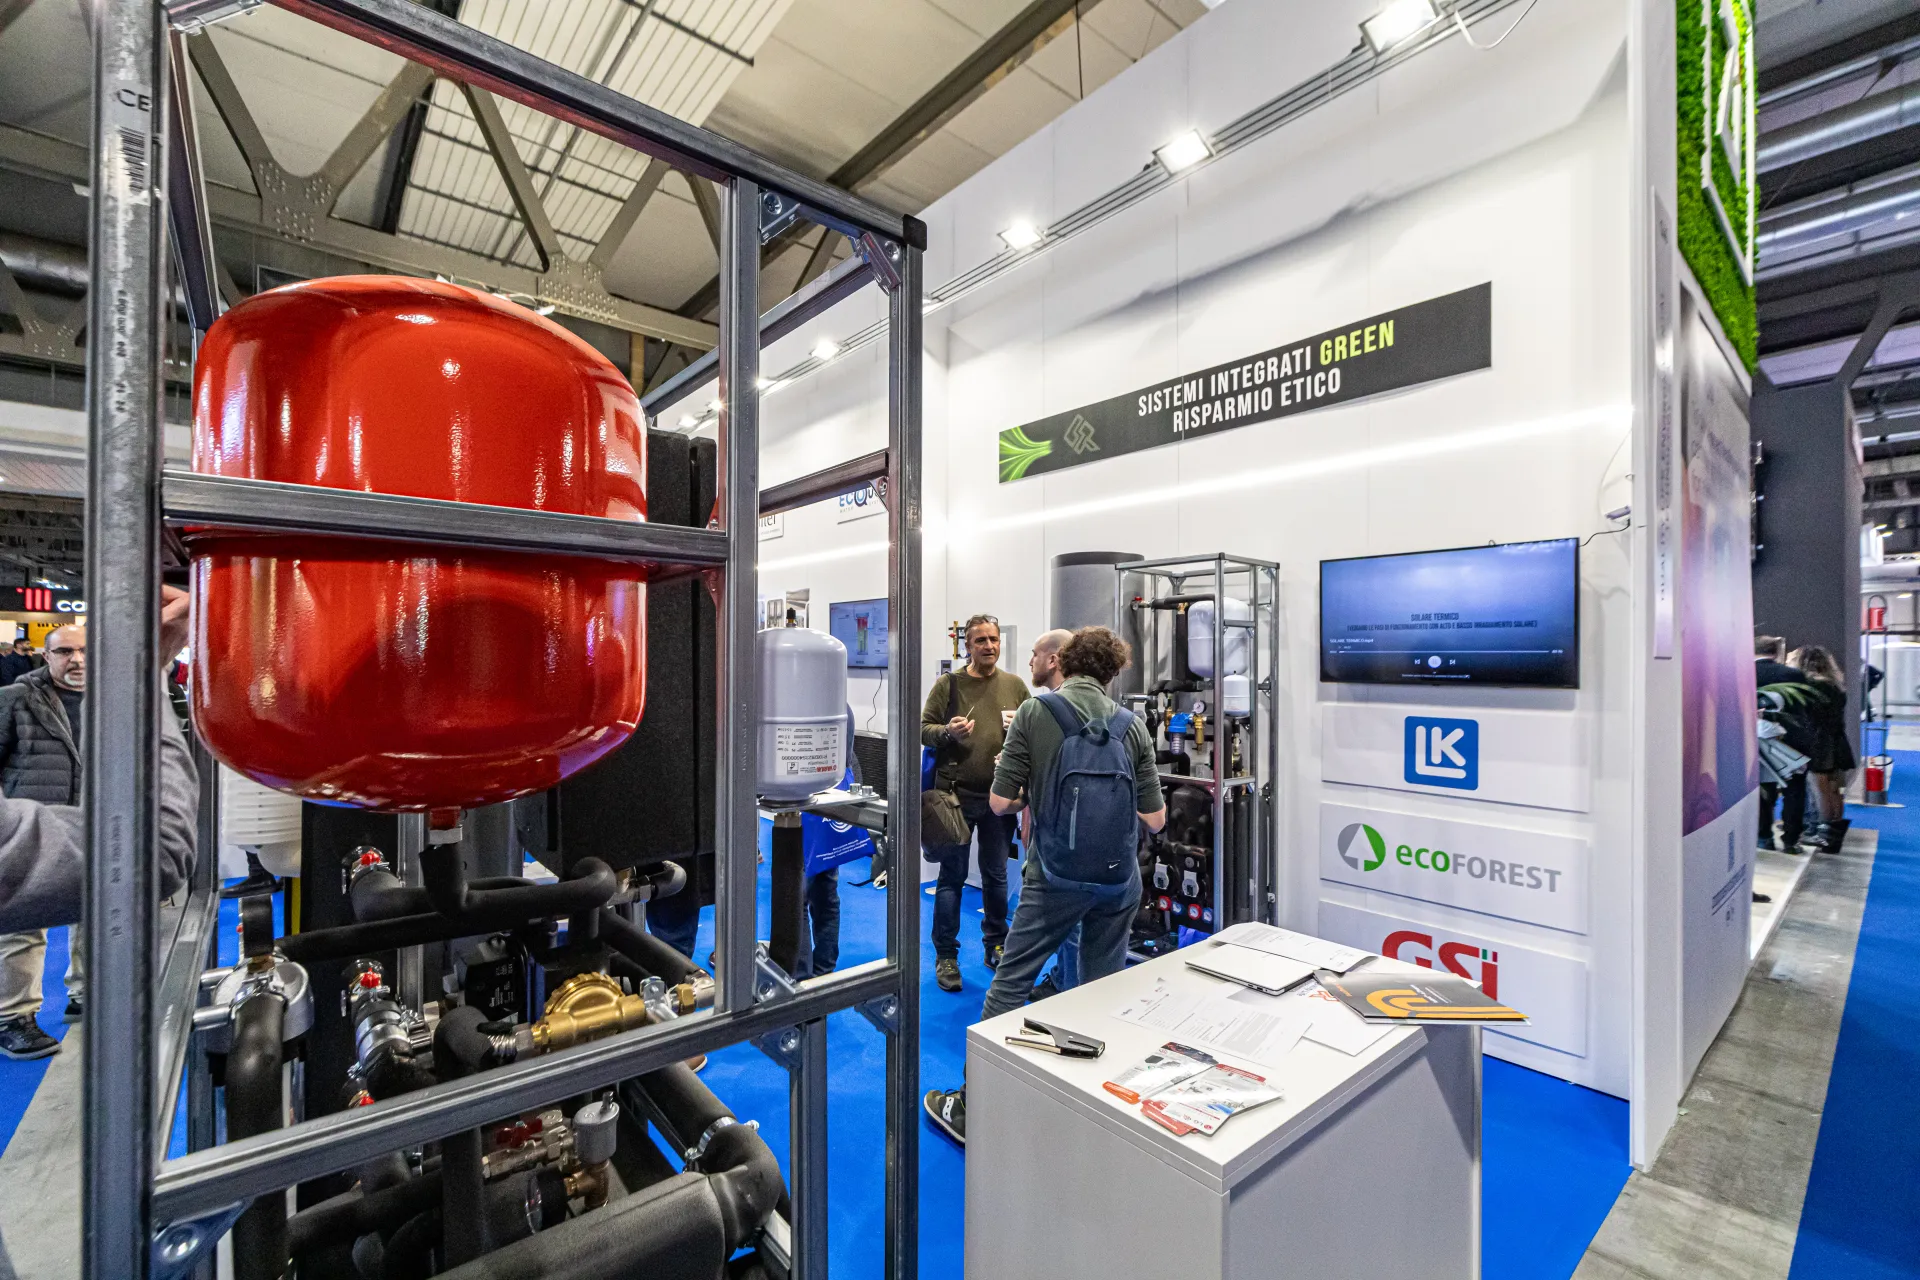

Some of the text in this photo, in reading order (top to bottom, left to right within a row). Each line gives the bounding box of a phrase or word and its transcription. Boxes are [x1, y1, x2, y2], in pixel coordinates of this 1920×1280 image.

[1138, 319, 1395, 417] SISTEMI INTEGRATI GREEN
[1172, 367, 1341, 432] RISPARMIO ETICO
[1410, 612, 1459, 622] SOLARE TERMICO
[1415, 725, 1466, 779] LK
[1395, 844, 1562, 893] ecoFOREST
